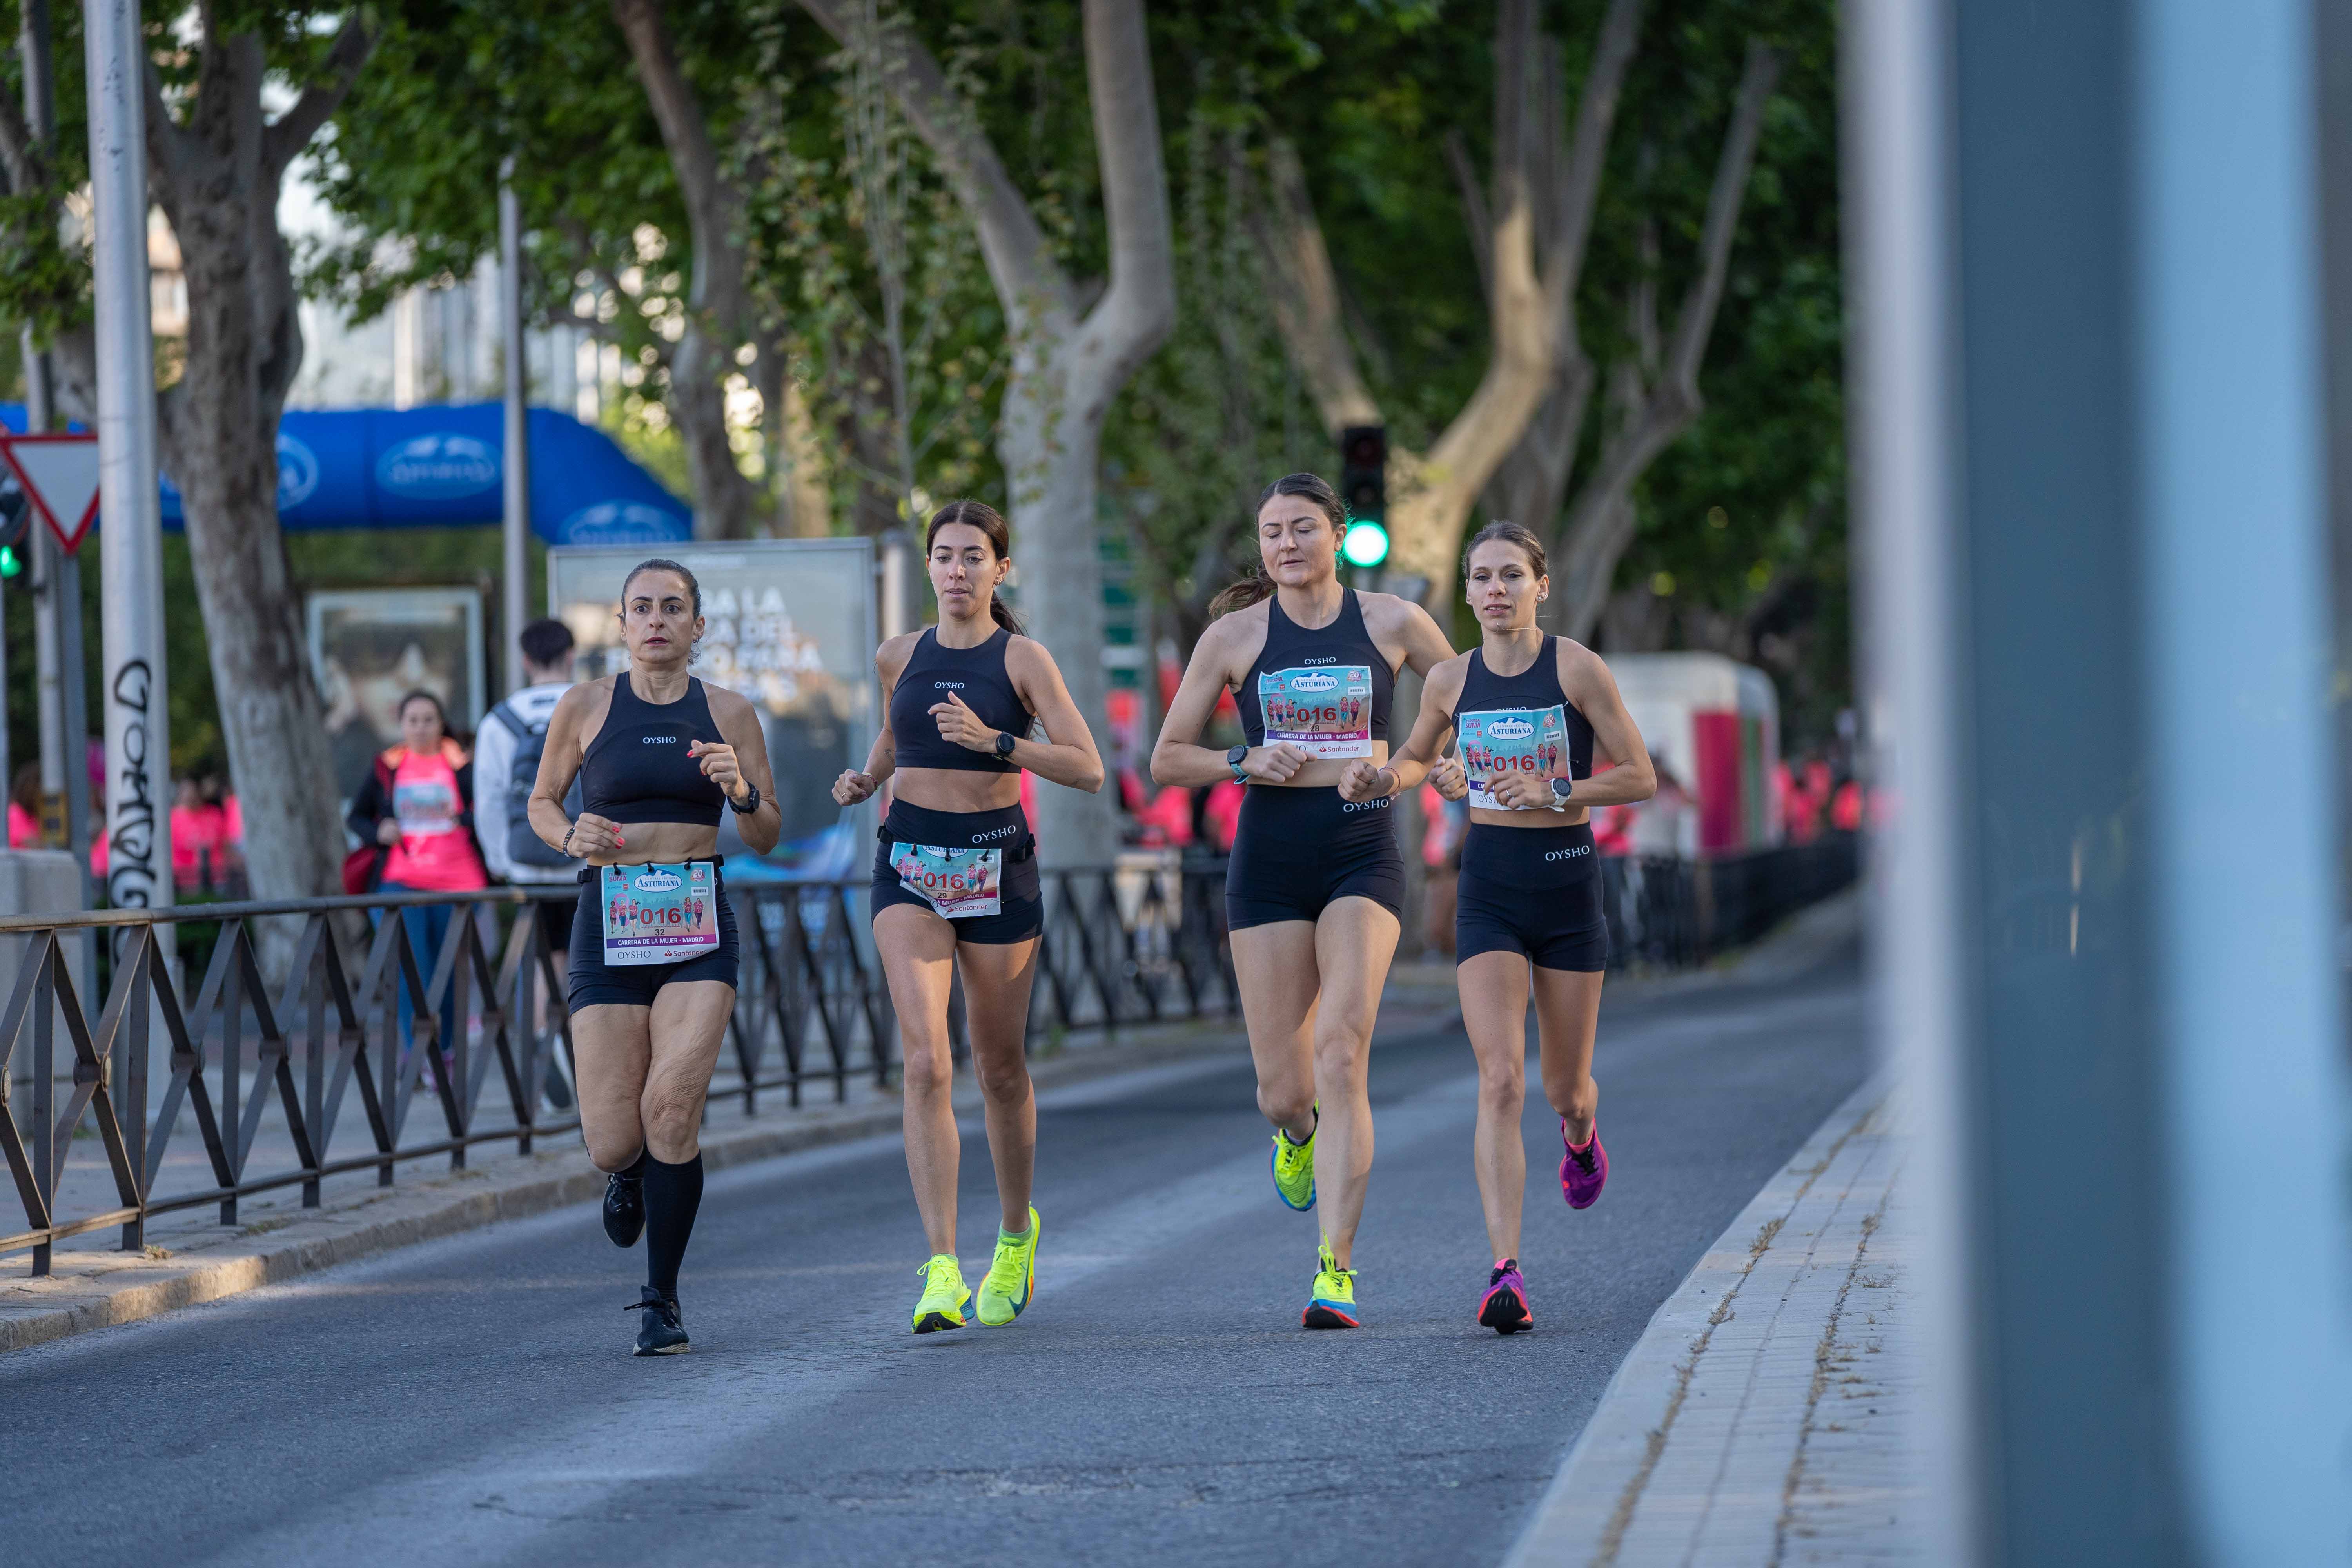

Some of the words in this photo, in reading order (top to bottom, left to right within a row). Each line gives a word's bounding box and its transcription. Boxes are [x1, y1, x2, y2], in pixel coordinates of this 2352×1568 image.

[1304, 657, 1336, 665] OYSHO
[1294, 679, 1335, 688] ASTURIANA
[1296, 708, 1336, 722] 016
[1490, 726, 1531, 735] ASTURIANA
[1494, 755, 1535, 772] 016
[1343, 799, 1388, 812] OYSHO
[972, 825, 1016, 843] OYSHO
[1545, 845, 1590, 861] OYSHO
[638, 878, 679, 887] ASTURIANA
[924, 872, 964, 889] 016
[640, 908, 681, 924] 016
[617, 950, 651, 959] OYSHO
